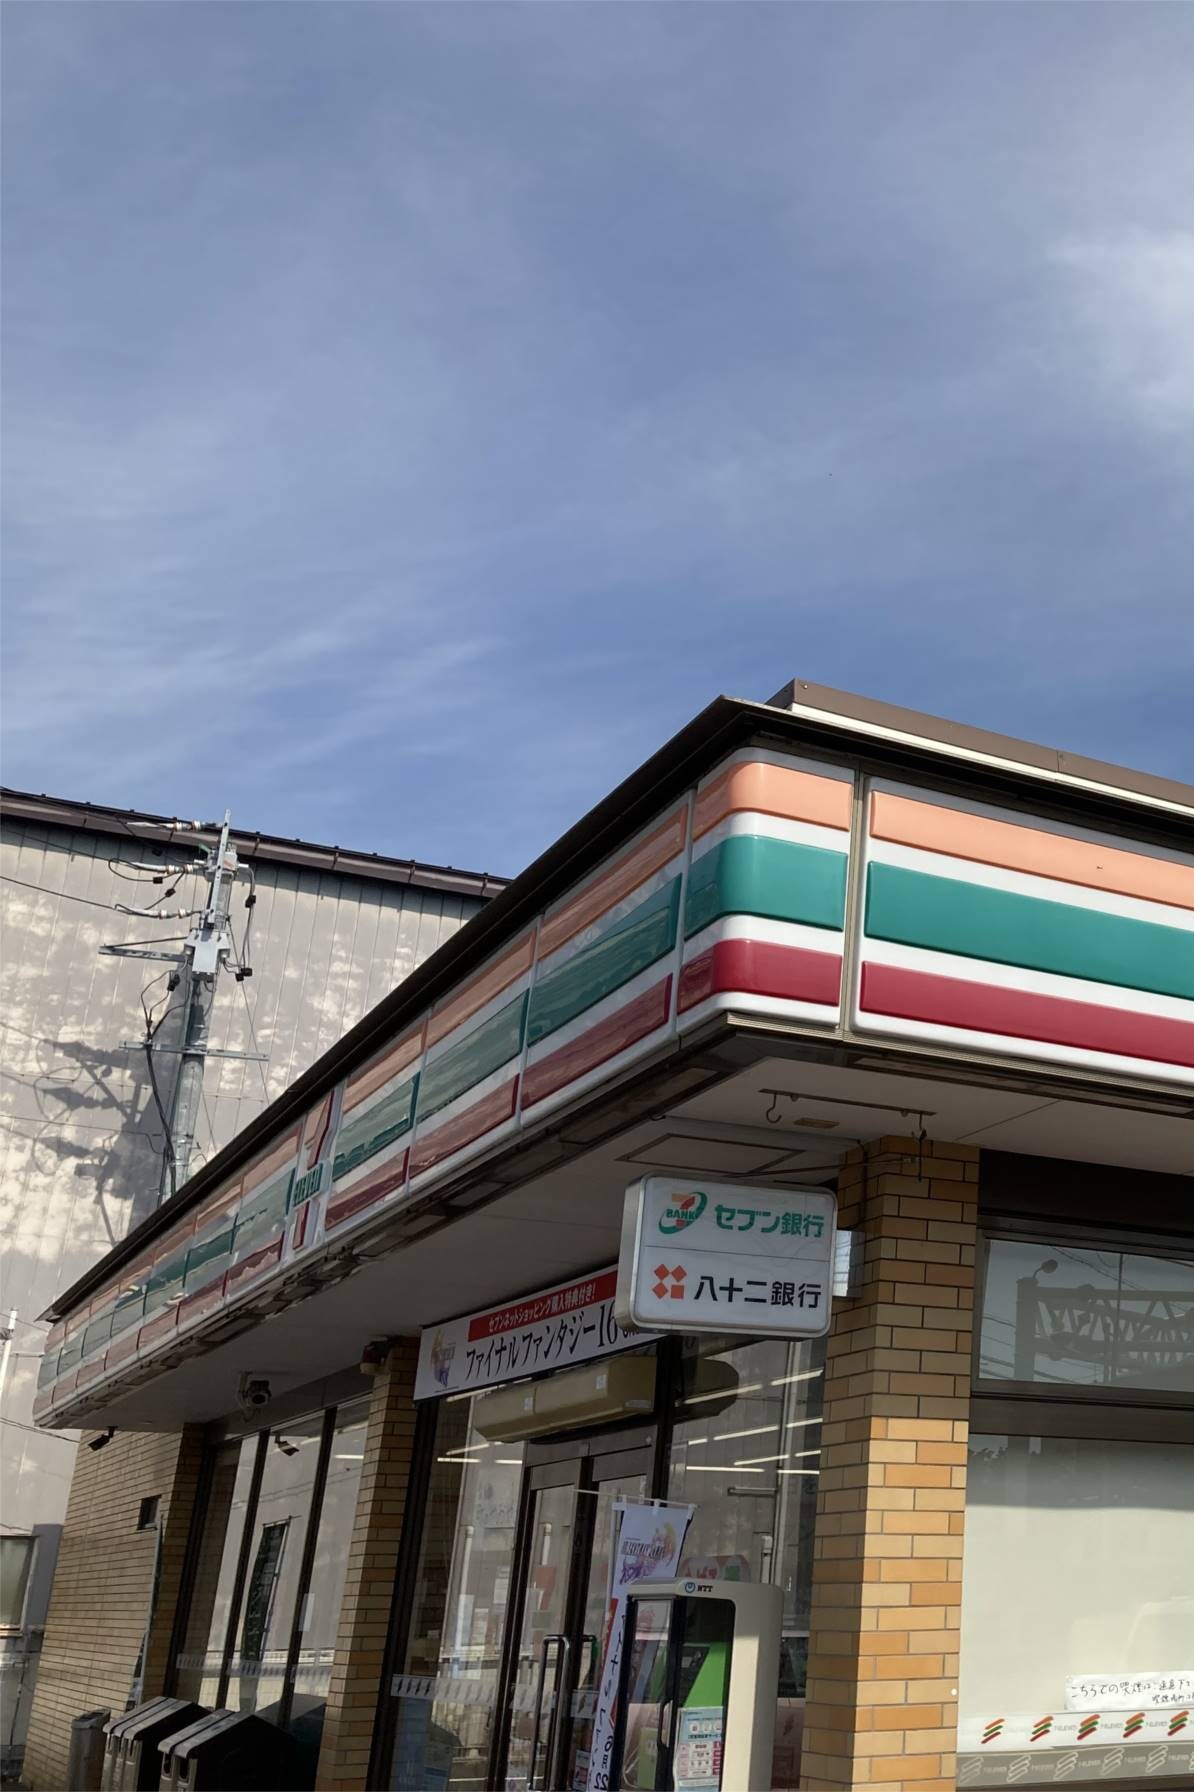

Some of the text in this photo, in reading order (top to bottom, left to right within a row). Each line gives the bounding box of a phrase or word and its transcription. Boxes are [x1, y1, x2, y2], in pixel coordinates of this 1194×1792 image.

[715, 1204, 825, 1239] セブン銀行
[694, 1275, 822, 1309] 八十二銀行
[697, 1585, 714, 1593] NTT
